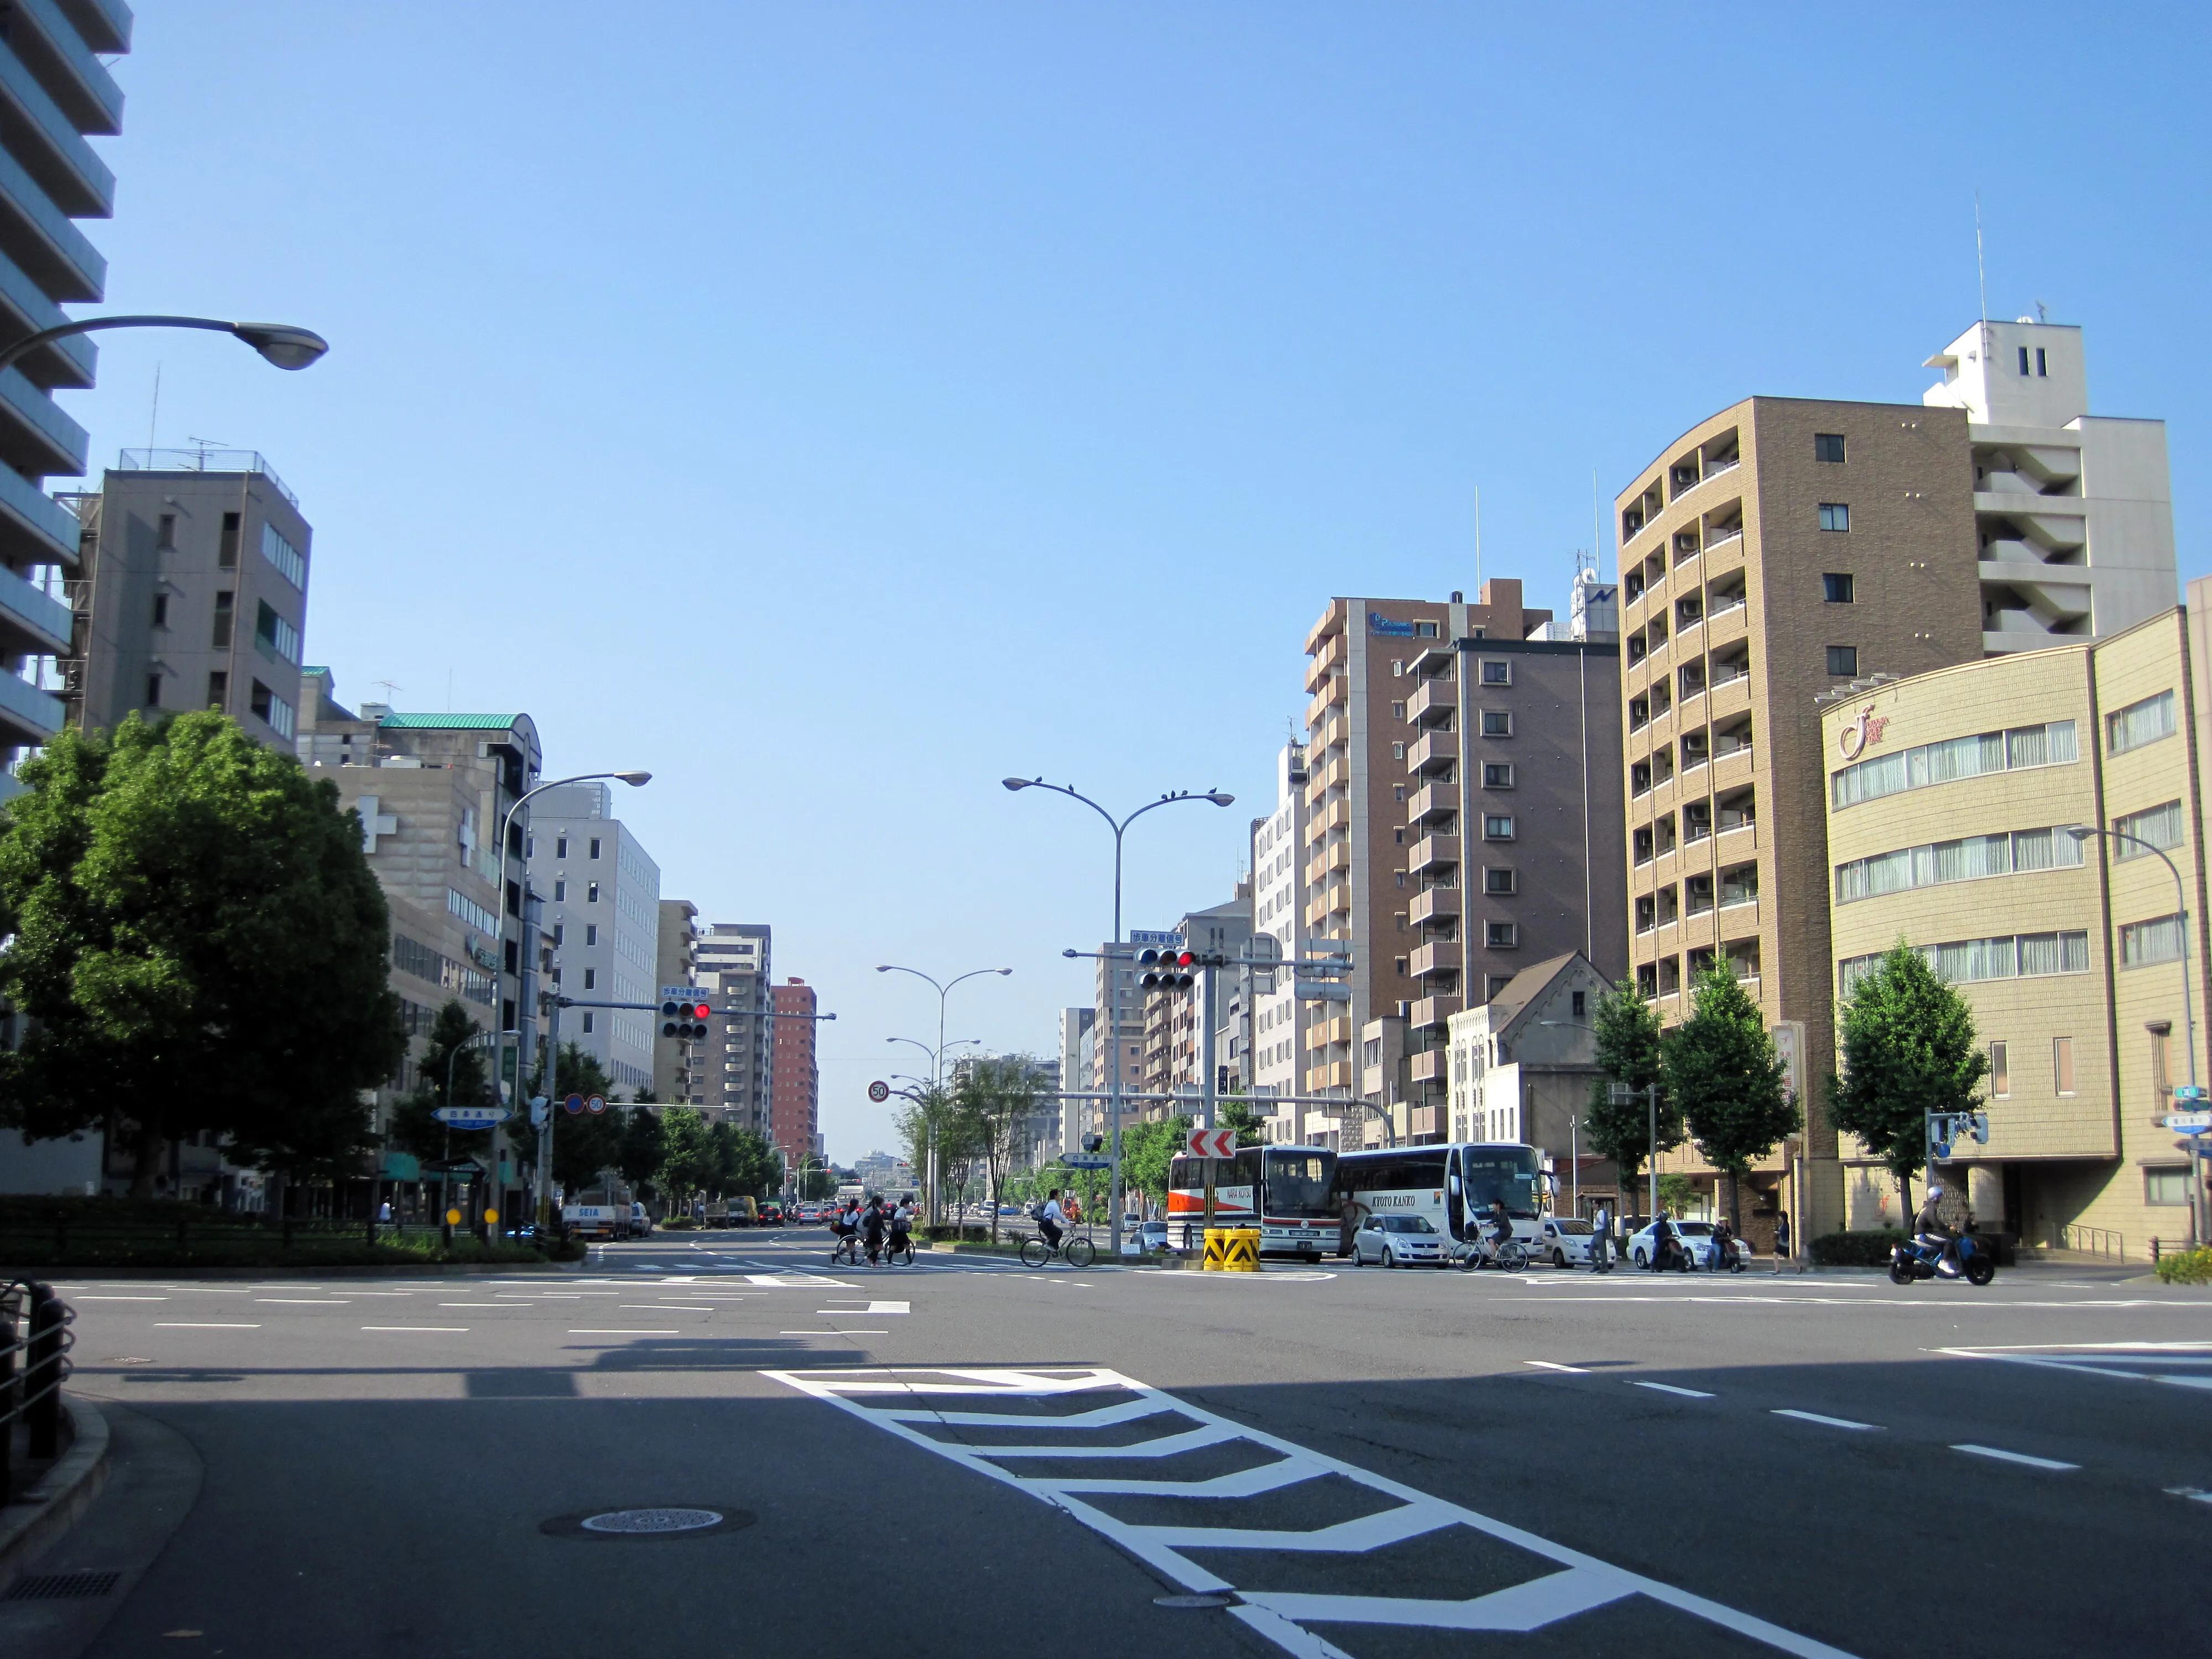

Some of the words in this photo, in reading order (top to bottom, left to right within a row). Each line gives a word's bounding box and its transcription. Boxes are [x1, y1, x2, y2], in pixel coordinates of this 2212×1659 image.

[1133, 932, 1183, 944] 歩車分離信号
[873, 1086, 885, 1096] 50
[591, 1100, 602, 1108] 50
[1227, 1188, 1238, 1199] NARA
[1239, 1187, 1251, 1198] KOTSU
[1372, 1196, 1392, 1207] KYOTO
[1393, 1195, 1416, 1207] KANKO
[579, 1208, 599, 1217] SEIA
